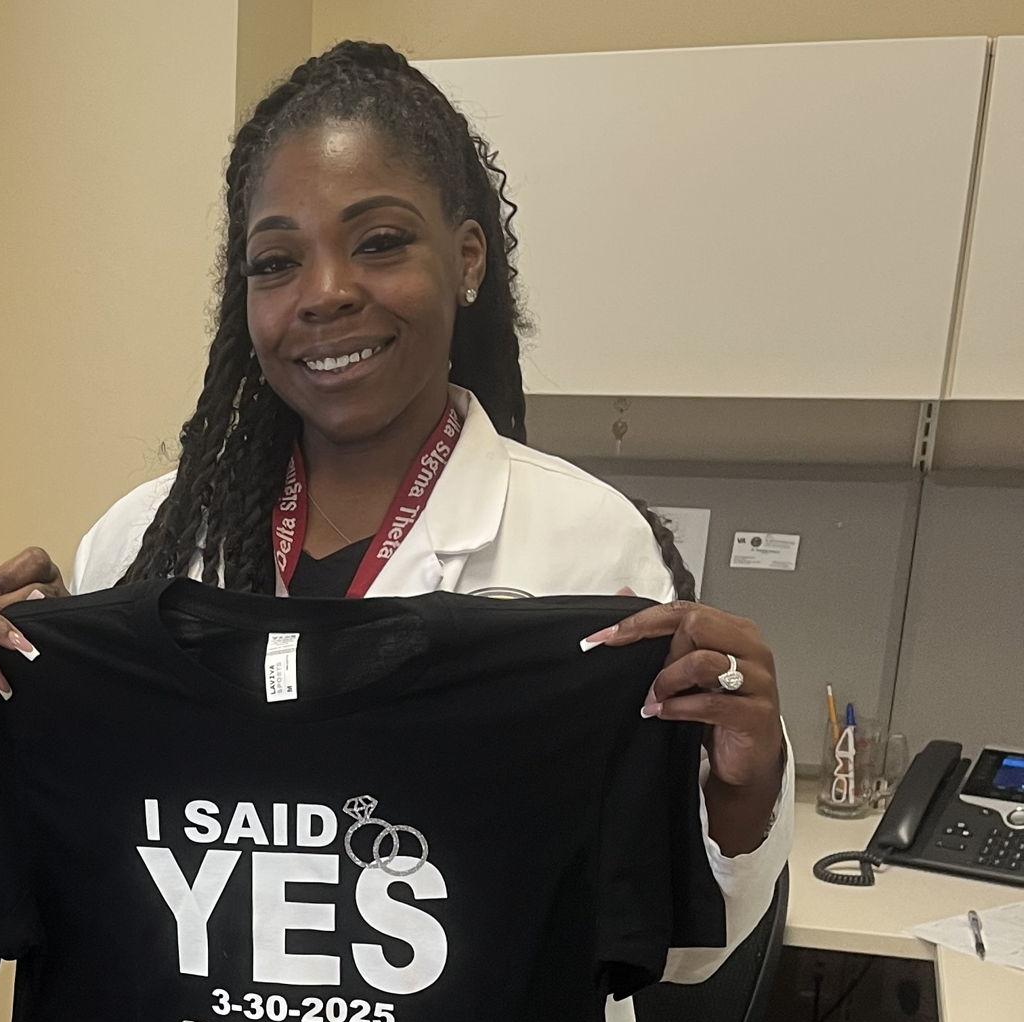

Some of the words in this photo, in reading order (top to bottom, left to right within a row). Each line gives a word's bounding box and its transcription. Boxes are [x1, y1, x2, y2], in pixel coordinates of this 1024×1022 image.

[408, 441, 450, 497] Sigma
[276, 517, 297, 572] Delta
[376, 505, 421, 559] Theta
[144, 799, 161, 841] I
[183, 799, 339, 848] SAID
[136, 845, 448, 995] YES
